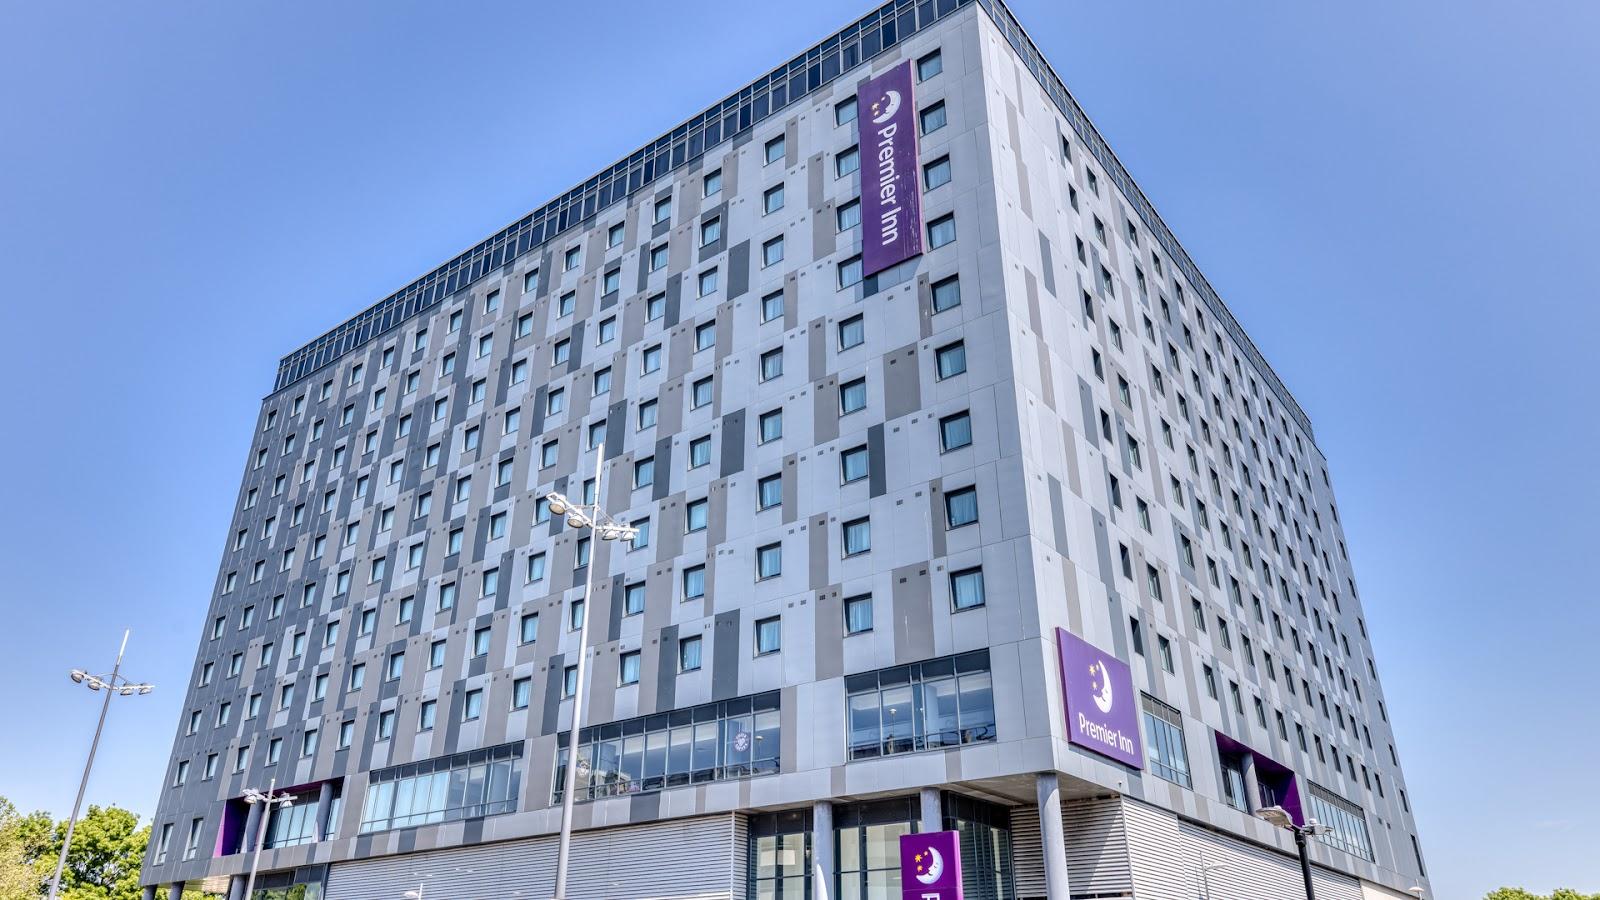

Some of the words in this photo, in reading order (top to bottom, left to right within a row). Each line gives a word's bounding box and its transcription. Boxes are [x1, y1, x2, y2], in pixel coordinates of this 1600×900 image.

[878, 122, 900, 206] Premier
[881, 206, 902, 246] Inn
[1078, 712, 1117, 747] Premier
[1118, 729, 1134, 755] Inn
